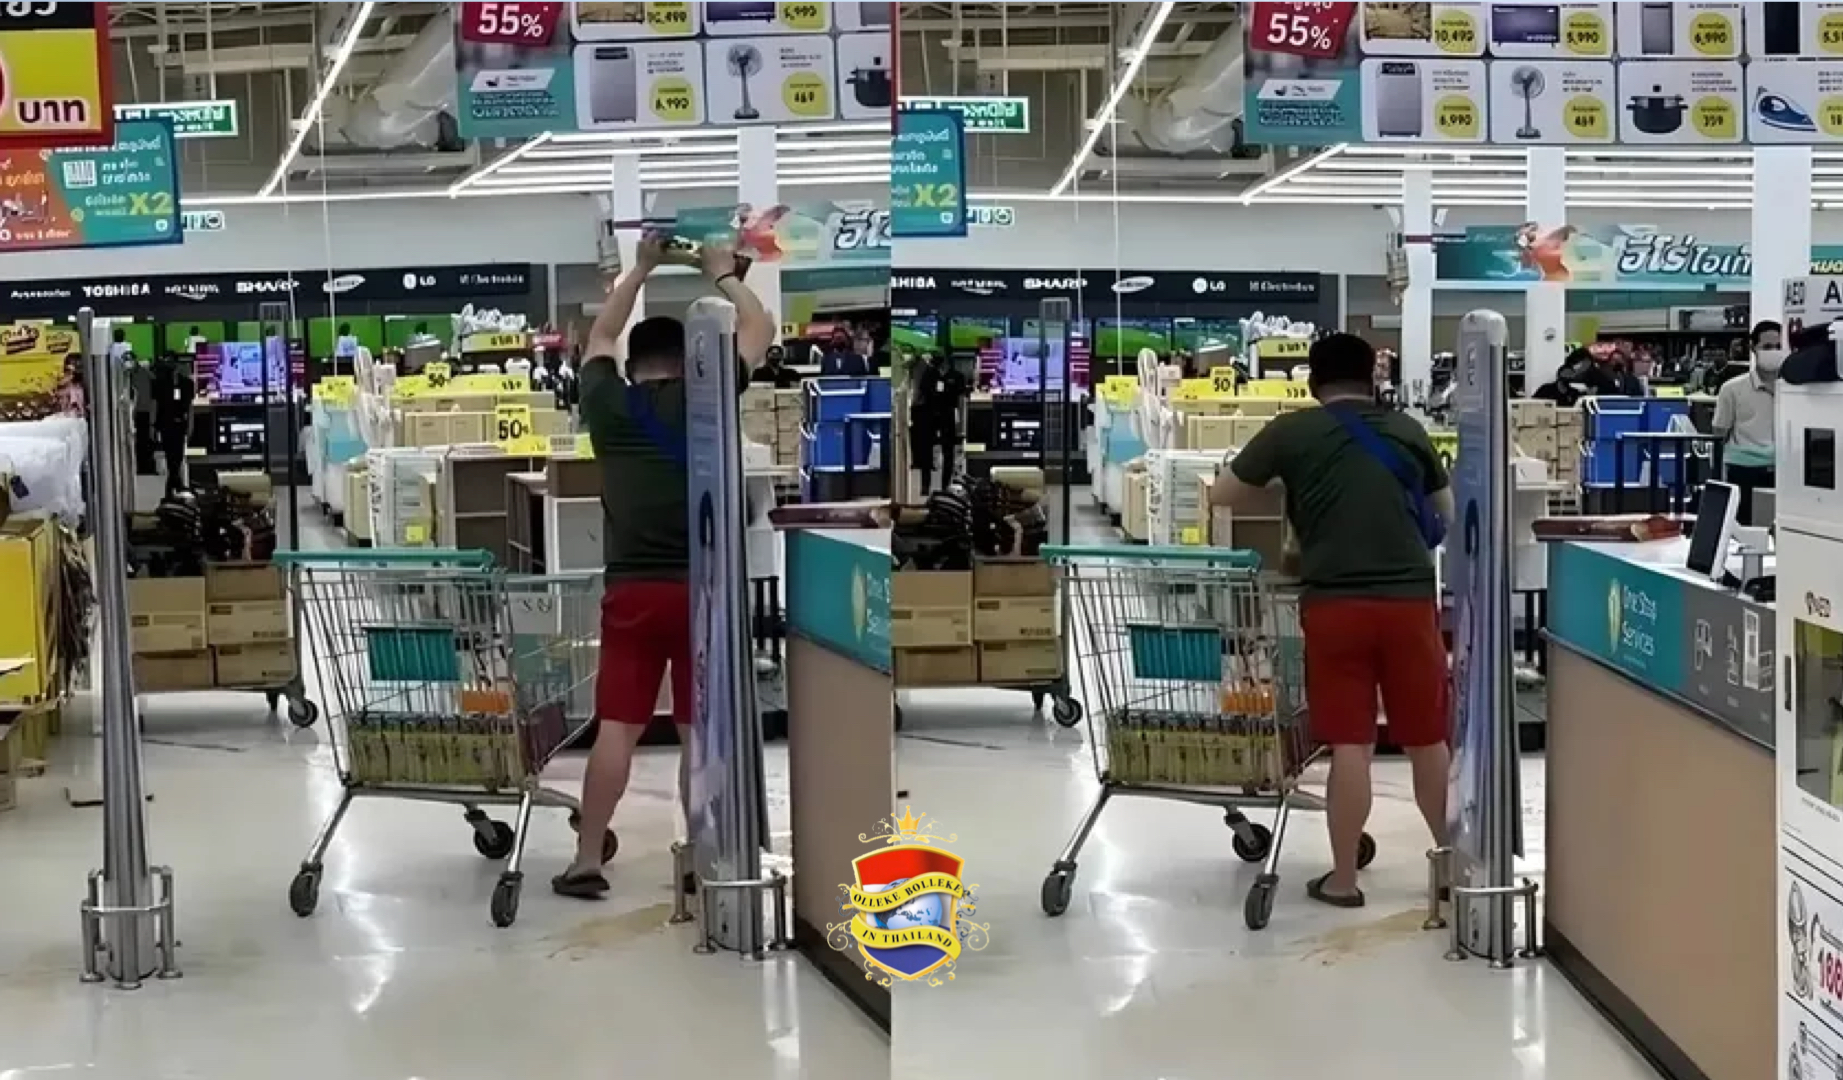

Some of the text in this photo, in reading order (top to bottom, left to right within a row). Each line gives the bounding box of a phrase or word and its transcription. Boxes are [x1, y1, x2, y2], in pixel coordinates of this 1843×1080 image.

[478, 4, 543, 37] 55%
[1267, 12, 1331, 49] 55%
[18, 99, 86, 123] บาท
[129, 192, 174, 215] X2
[914, 183, 957, 207] X2
[1023, 278, 1088, 289] SHARP
